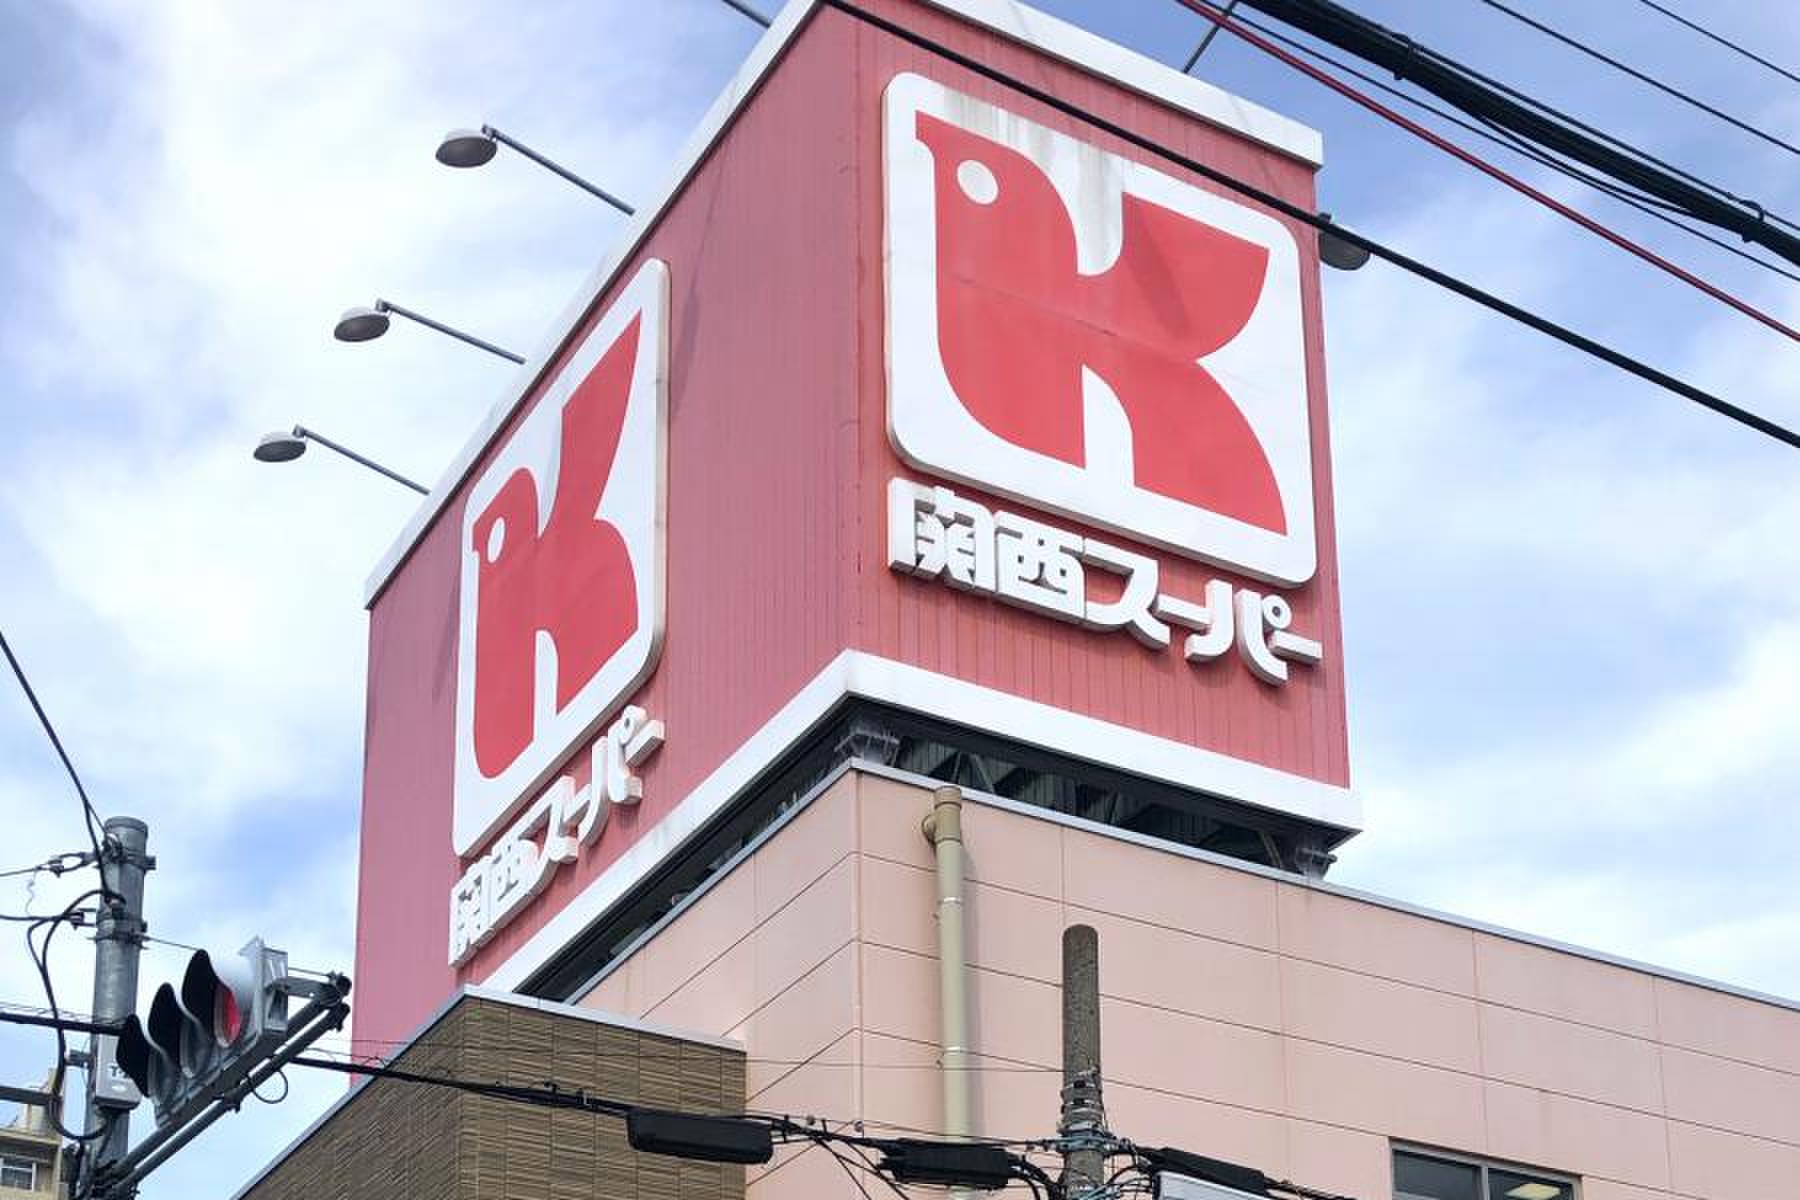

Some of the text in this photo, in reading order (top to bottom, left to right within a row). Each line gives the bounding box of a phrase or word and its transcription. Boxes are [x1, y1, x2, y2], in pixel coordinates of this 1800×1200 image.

[887, 477, 1323, 687] 関西スーパー
[448, 704, 665, 967] 関西スーパー
